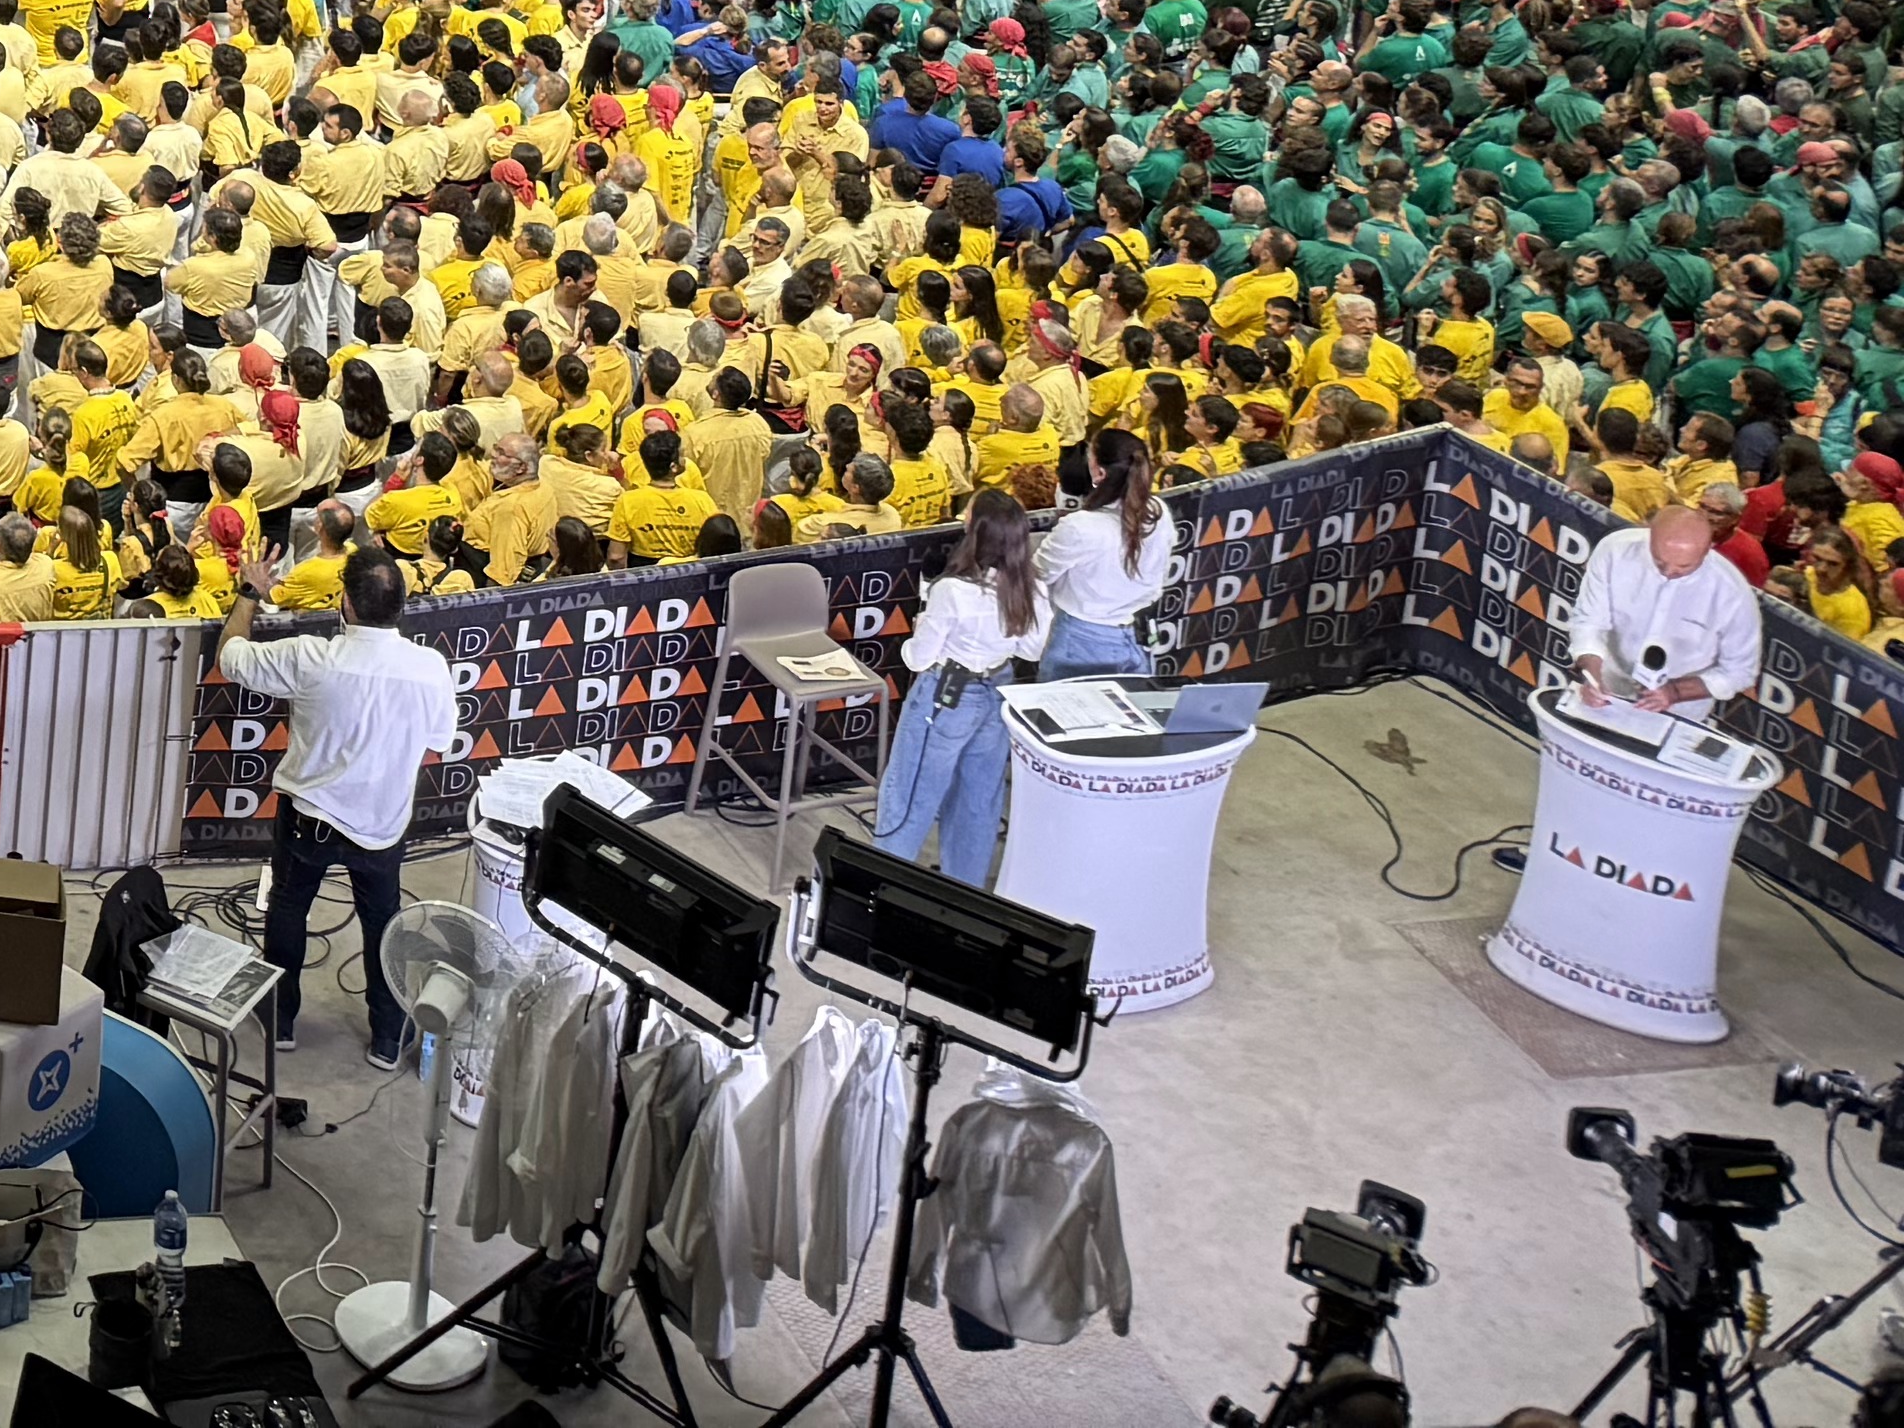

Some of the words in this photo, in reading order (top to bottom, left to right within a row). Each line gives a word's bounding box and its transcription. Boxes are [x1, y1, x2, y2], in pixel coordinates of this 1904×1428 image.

[1318, 499, 1416, 547] DIADA
[1424, 461, 1481, 510] LA
[1490, 488, 1590, 565] DIAD
[515, 616, 574, 651] LA
[583, 596, 716, 642] DIADA
[509, 684, 567, 720] LA
[576, 665, 709, 713] DIADA
[1089, 780, 1111, 793] LA
[1116, 781, 1167, 794] DIADA
[1549, 832, 1586, 870] LA
[1594, 855, 1695, 902] DIADA
[1596, 980, 1621, 998] LA
[1626, 990, 1683, 1013] DIADA
